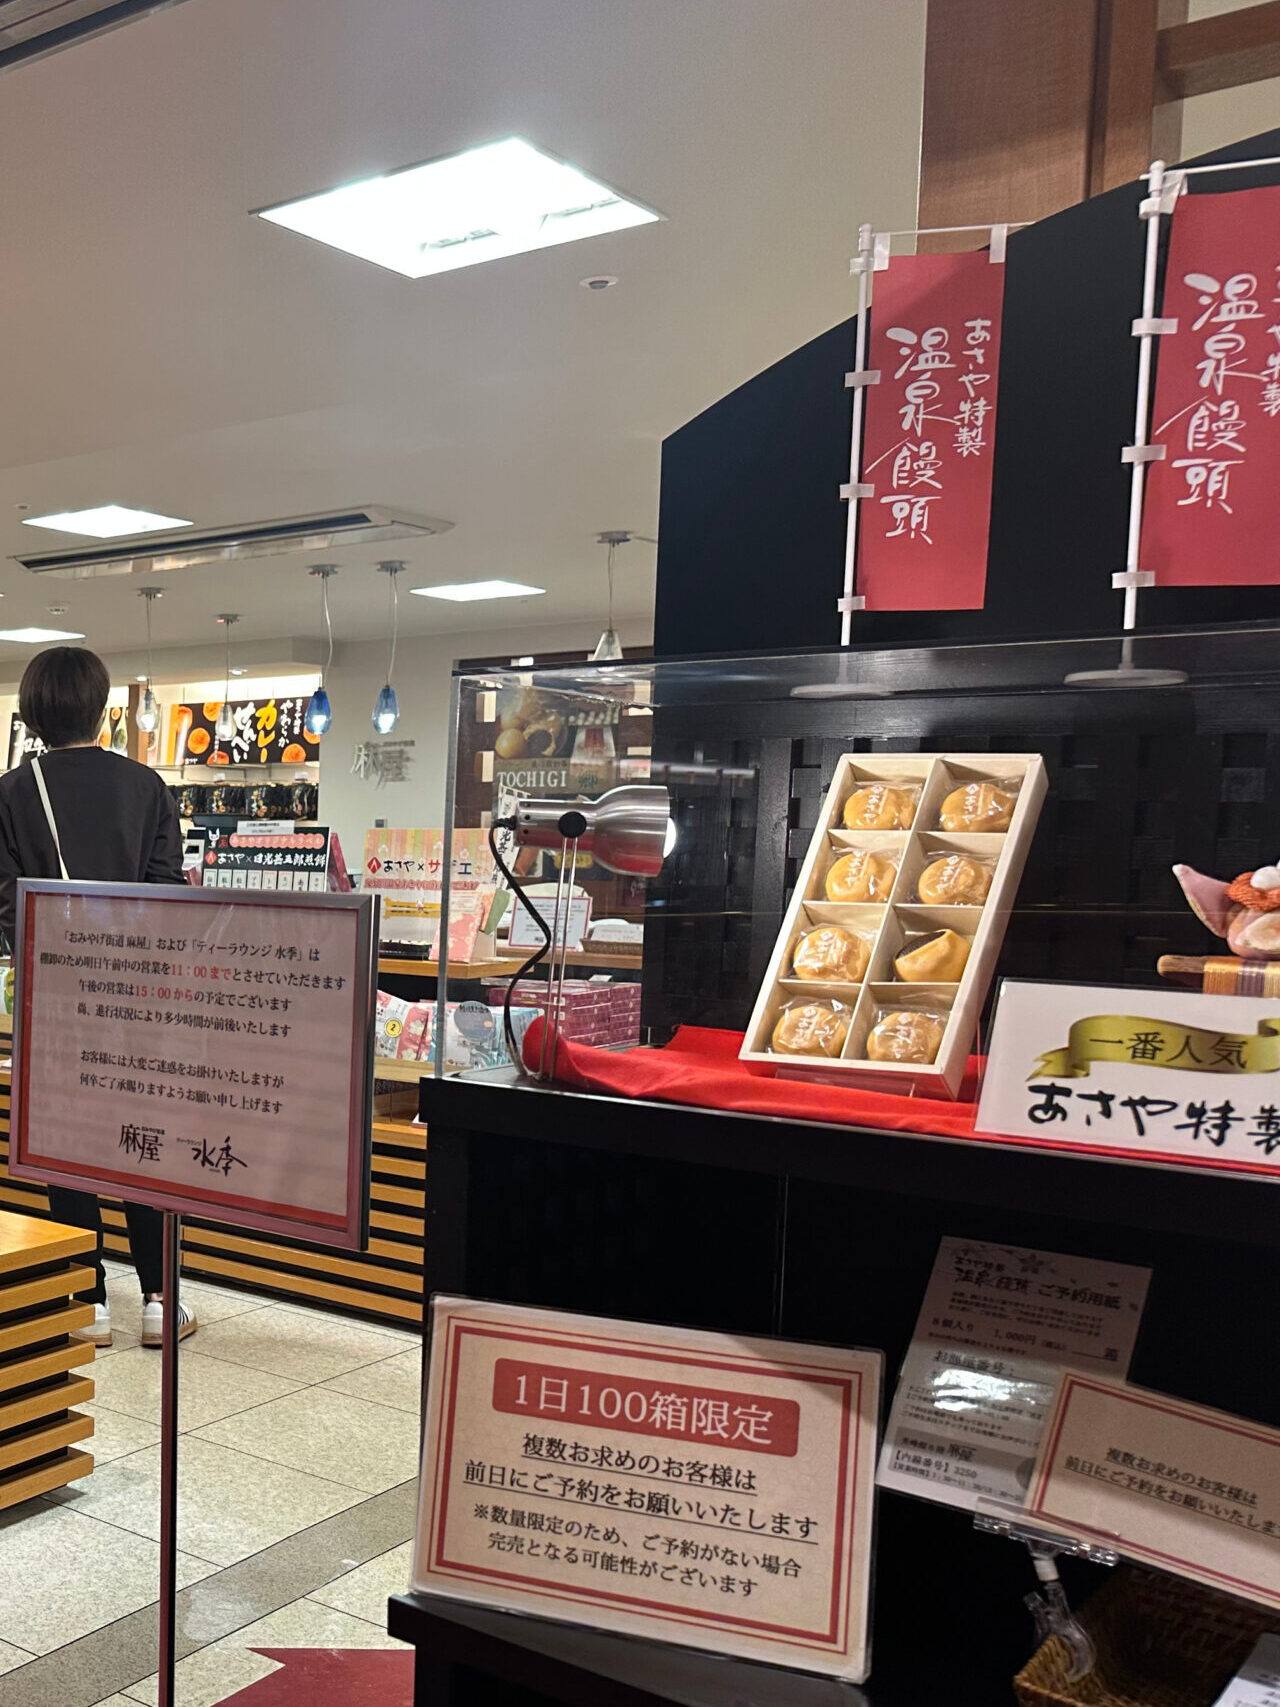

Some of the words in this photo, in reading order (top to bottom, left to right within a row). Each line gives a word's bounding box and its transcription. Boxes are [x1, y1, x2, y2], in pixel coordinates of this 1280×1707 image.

[953, 319, 993, 458] あさや特製
[1155, 273, 1270, 514] 温泉饅頭
[865, 327, 960, 544] 温泉饅頭
[231, 702, 257, 763] せんべい
[255, 699, 278, 763] カレー
[278, 700, 293, 748] やわらか
[497, 770, 567, 788] TOCHIGI
[1089, 1031, 1248, 1069] 一番人気
[118, 1123, 164, 1164] 麻屋
[192, 1136, 248, 1176] 水季
[514, 1374, 775, 1446] 1日100箱限定
[522, 1433, 757, 1491] 複数お求めのお客様は
[1065, 1455, 1280, 1533] 前日にご予約をお願いいたしま
[1106, 1448, 1258, 1505] 複数お求めのお客様は
[464, 1459, 819, 1539] 前日にご予約をお願いいたします
[473, 1504, 802, 1579] ※数量限定のため、ご予約がない場合
[489, 1532, 758, 1597] 完売となる可能性がございます
